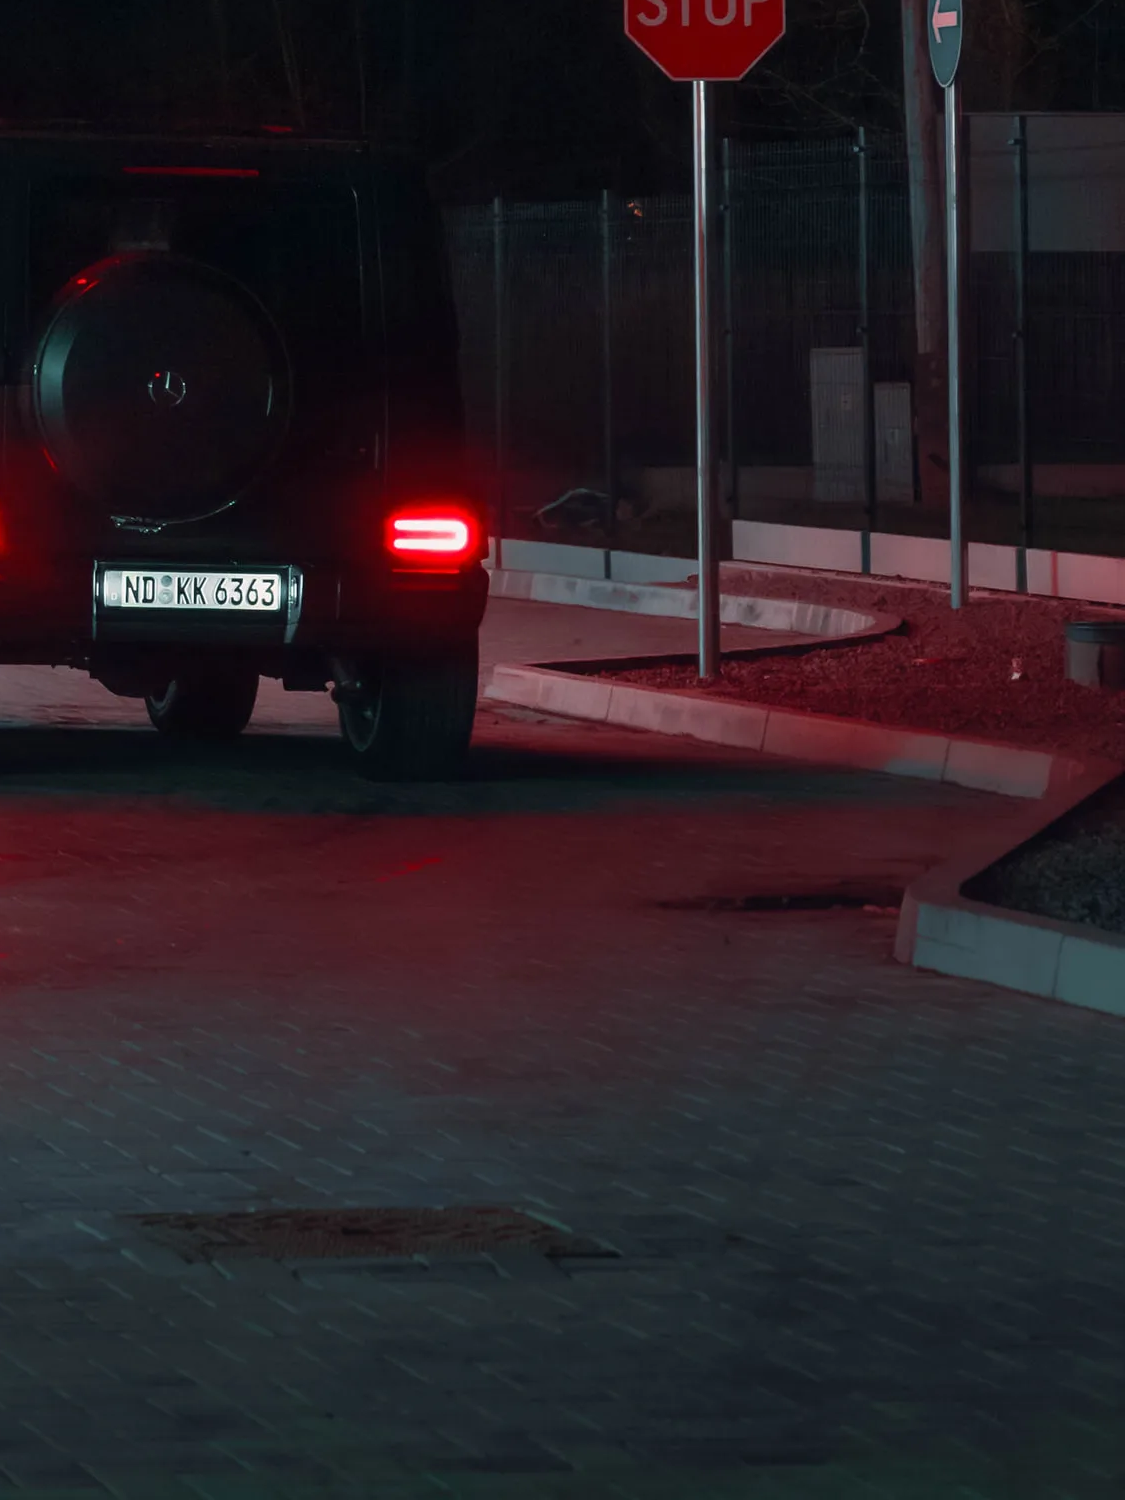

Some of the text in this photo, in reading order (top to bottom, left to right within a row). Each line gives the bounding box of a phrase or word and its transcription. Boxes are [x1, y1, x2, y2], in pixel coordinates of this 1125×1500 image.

[126, 576, 275, 606] ND KK 6363
